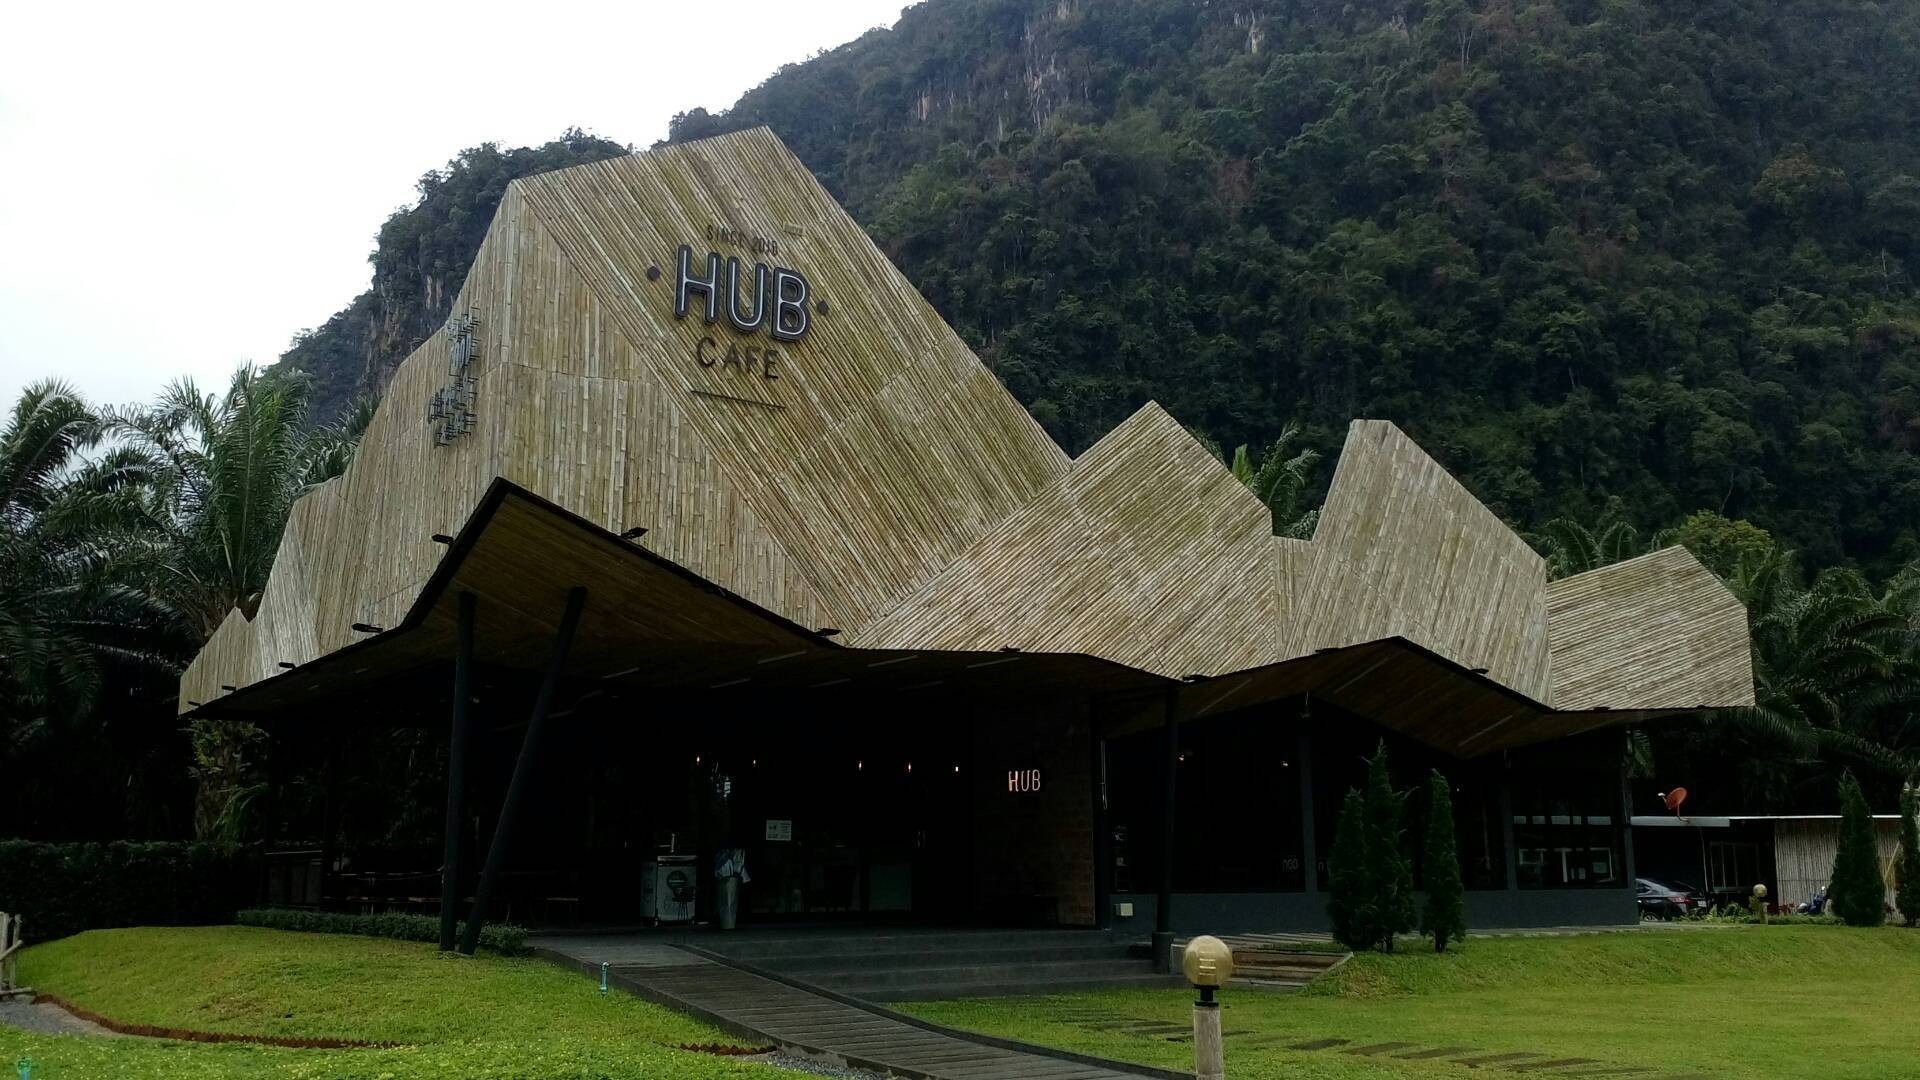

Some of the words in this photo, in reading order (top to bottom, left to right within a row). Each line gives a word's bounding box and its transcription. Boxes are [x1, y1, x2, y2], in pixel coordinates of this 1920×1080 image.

[706, 224, 743, 248] SINCE
[674, 243, 812, 343] HUB
[696, 336, 779, 380] CAFE
[1008, 769, 1041, 793] HUB
